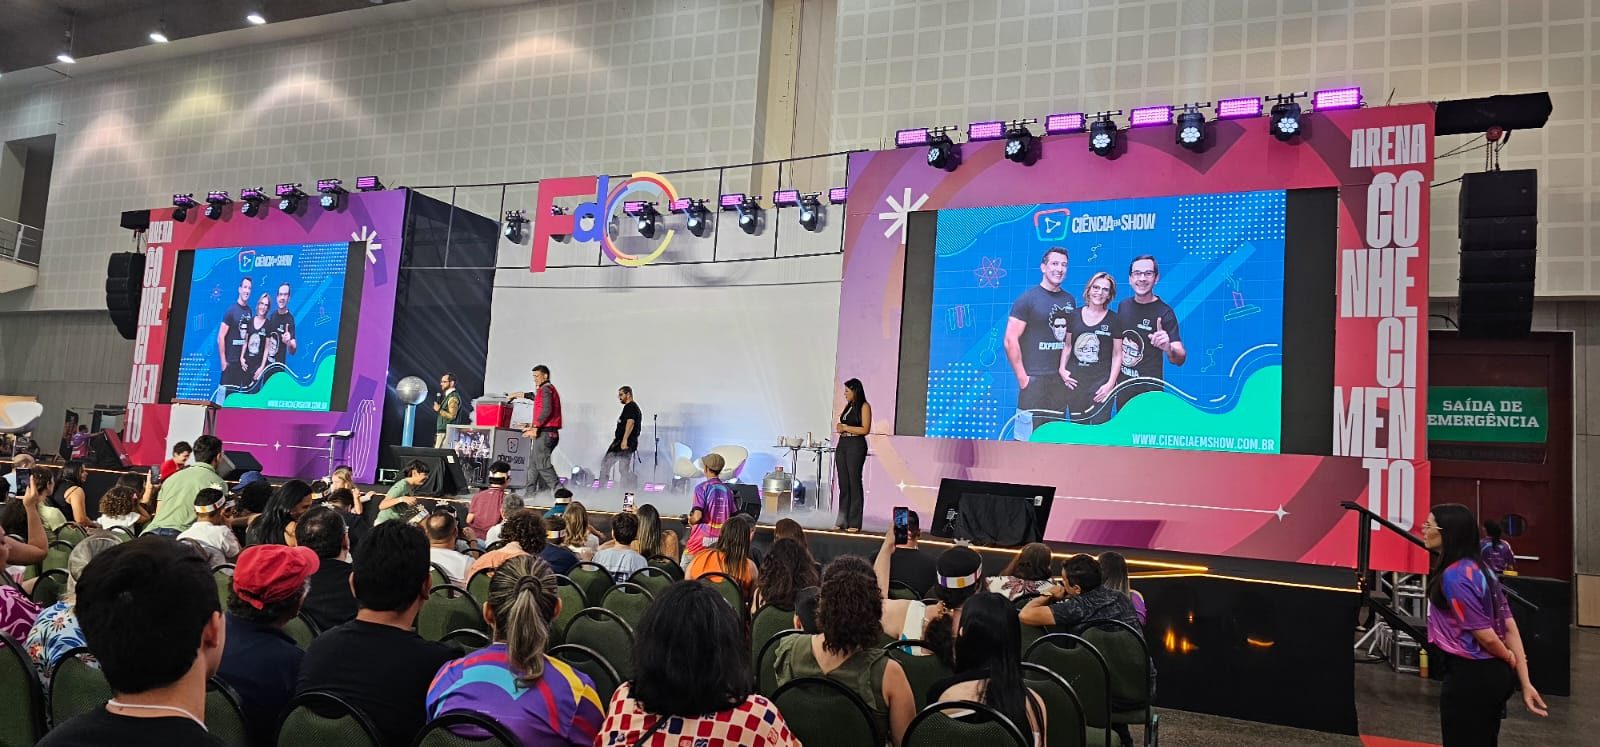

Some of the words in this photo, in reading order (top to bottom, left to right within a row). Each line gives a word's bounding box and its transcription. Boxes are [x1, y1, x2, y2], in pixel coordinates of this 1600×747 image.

[1350, 124, 1426, 168] ARENA
[1071, 214, 1114, 233] CIÊNCIA
[1120, 213, 1156, 231] SHOW
[1366, 170, 1424, 248] CO
[148, 221, 173, 243] ARENA
[143, 246, 163, 287] CO
[1341, 247, 1419, 317] NHE
[138, 287, 166, 325] NHE
[134, 325, 150, 364] CI
[1376, 317, 1418, 387] CI
[128, 364, 159, 403] MEN
[125, 402, 143, 443] TO
[1333, 386, 1416, 459] MEN
[1426, 413, 1540, 428] EMERGÊNCIA
[1443, 398, 1495, 411] SAÍDA
[1500, 400, 1523, 412] DE
[1132, 433, 1275, 450] WWW.CIENCIAEMSHOW.COM.BR
[1362, 458, 1415, 531] TO
